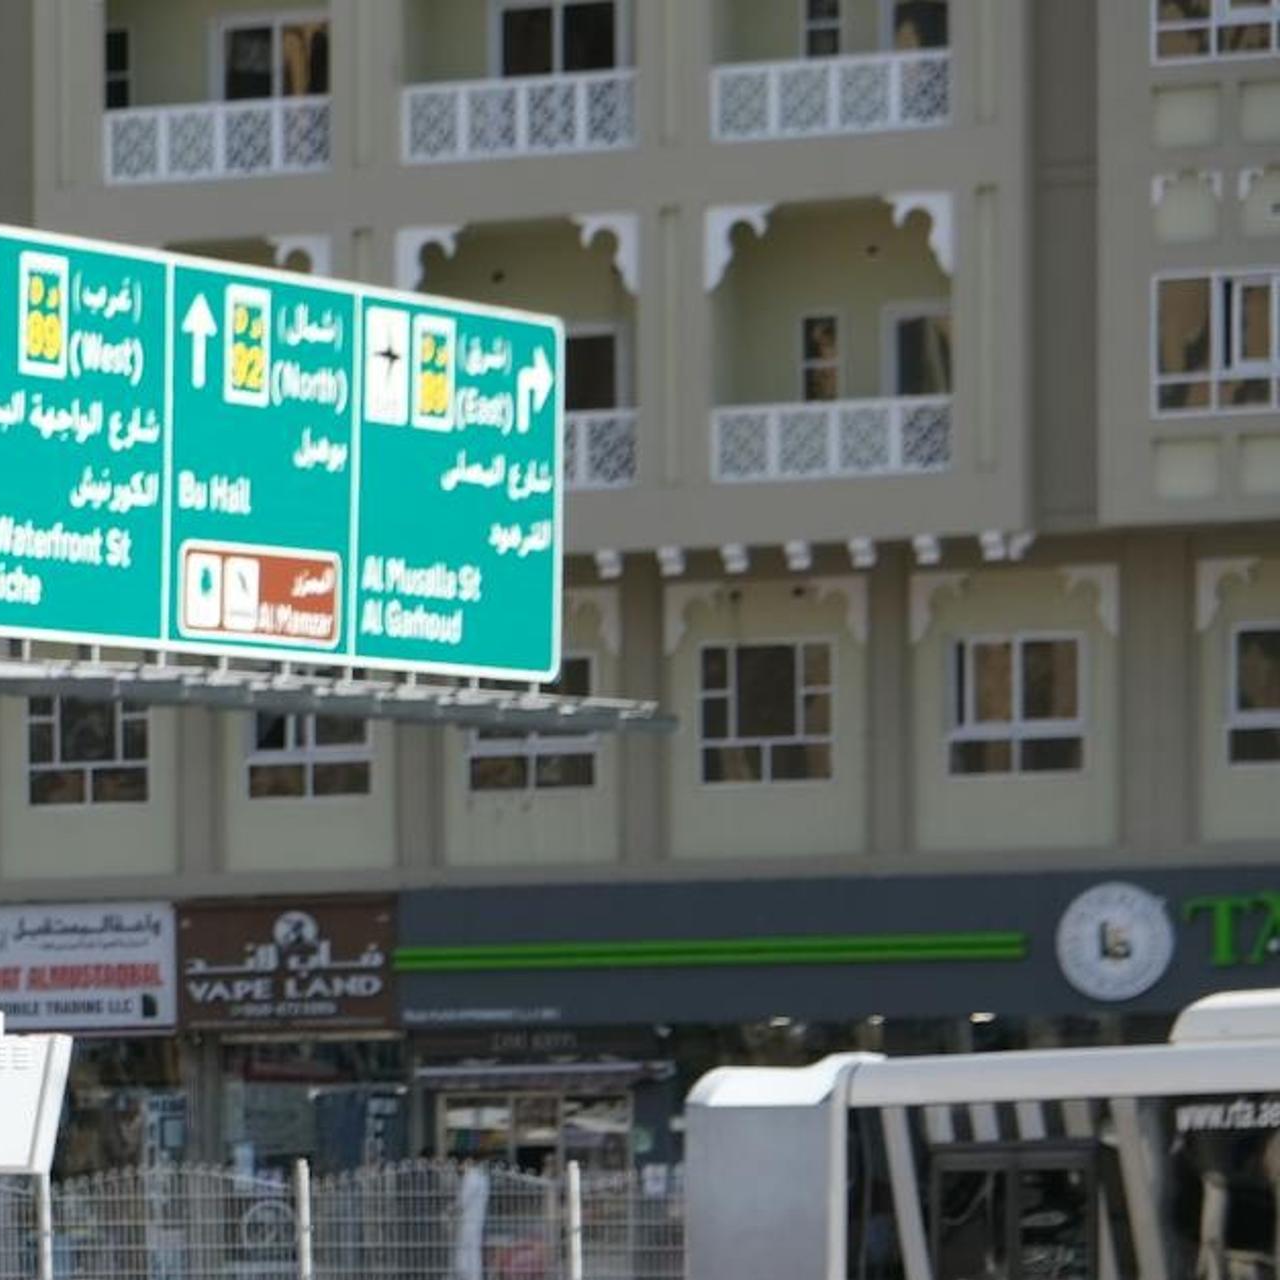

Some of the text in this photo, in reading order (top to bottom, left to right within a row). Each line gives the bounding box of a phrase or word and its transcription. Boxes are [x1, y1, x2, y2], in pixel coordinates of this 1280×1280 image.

[105, 526, 132, 569] St
[360, 555, 386, 592] Al
[458, 564, 482, 603] St
[360, 598, 463, 646] Al Garhoud
[187, 975, 385, 1004] VAPE LAND
